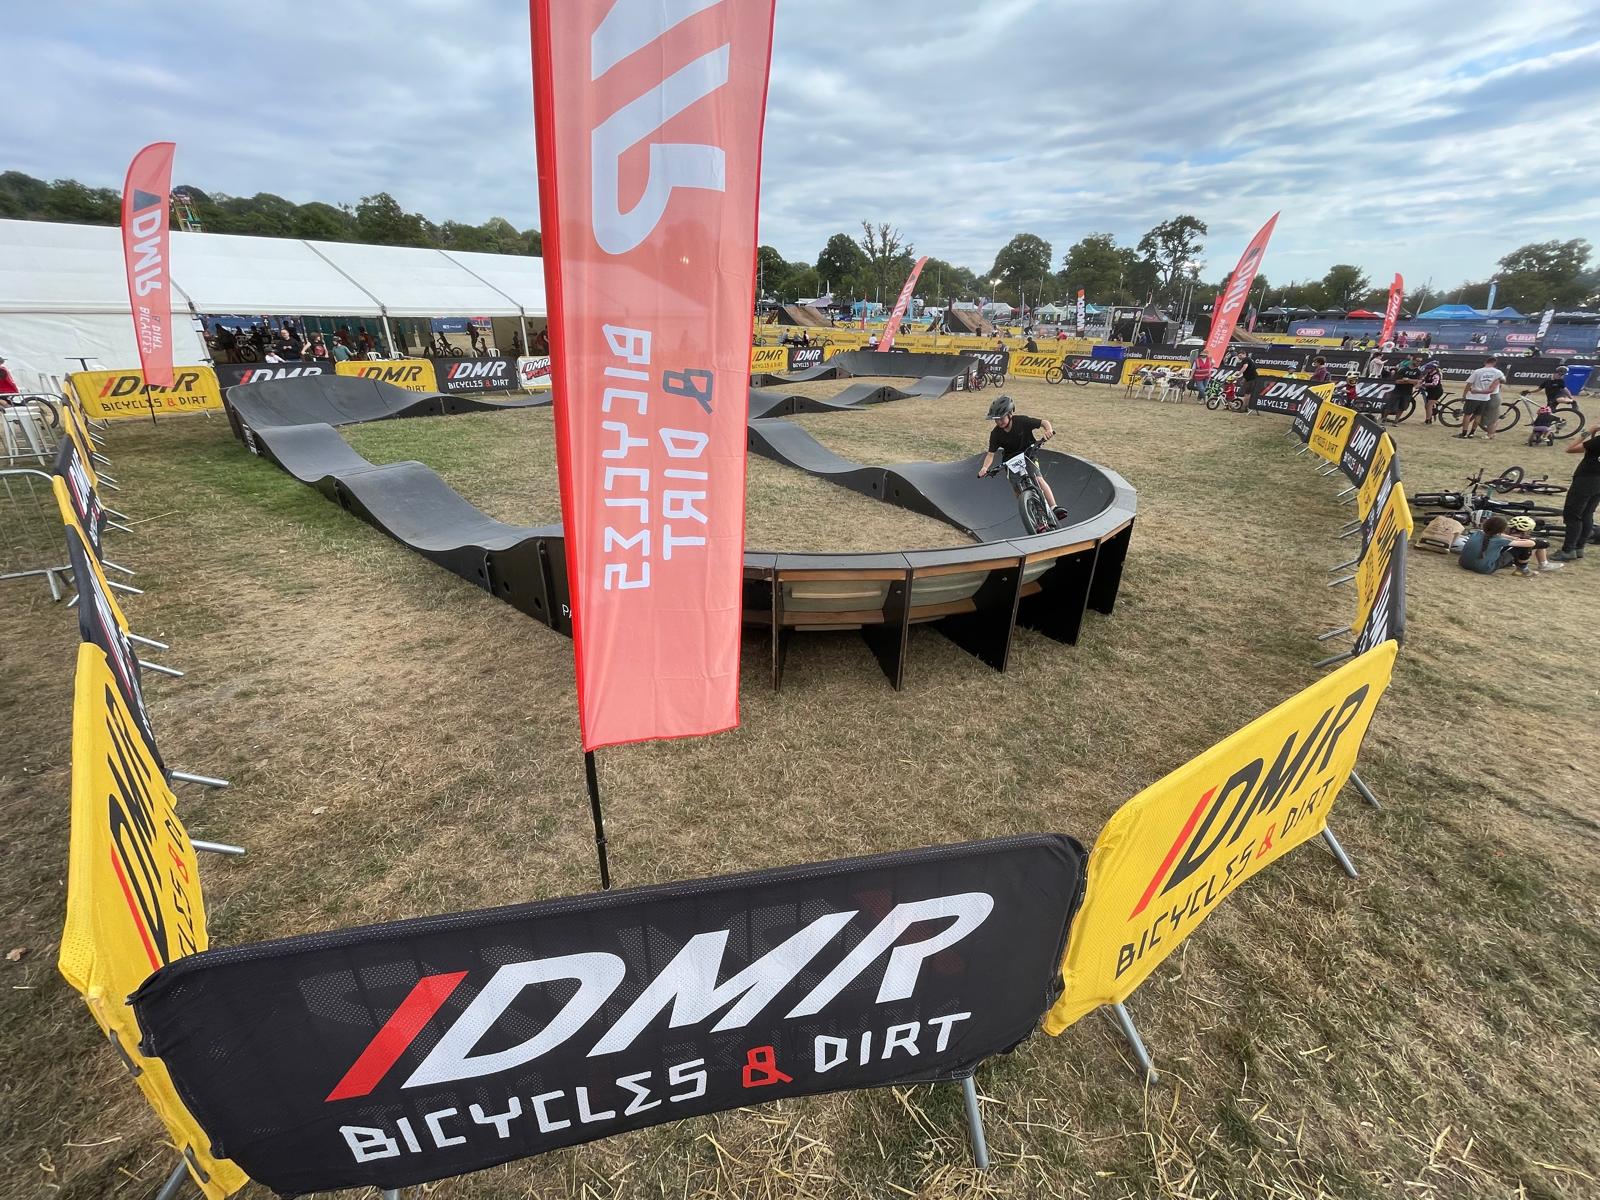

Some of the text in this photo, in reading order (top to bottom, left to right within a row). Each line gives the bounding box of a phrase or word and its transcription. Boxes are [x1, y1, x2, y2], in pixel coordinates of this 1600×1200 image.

[756, 350, 783, 361] DMR
[795, 350, 821, 361] DMR
[1020, 356, 1057, 367] DMR
[1255, 358, 1299, 366] cannondale
[454, 361, 507, 379] DMR
[526, 358, 549, 371] DMR
[1075, 360, 1117, 372] DMR
[448, 380, 483, 389] BICYCLES
[492, 379, 509, 387] DIRT
[180, 395, 207, 406] DIRT
[1256, 399, 1289, 410] BICYCLES
[1300, 397, 1318, 422] DMR
[1319, 410, 1348, 438] DMR
[1350, 425, 1377, 460] DMR
[1159, 683, 1370, 898] DMR
[1115, 775, 1336, 980] BICYCLES & DIRT
[400, 892, 994, 1090] DMR
[339, 1011, 971, 1165] BICYCLES & DIRT
